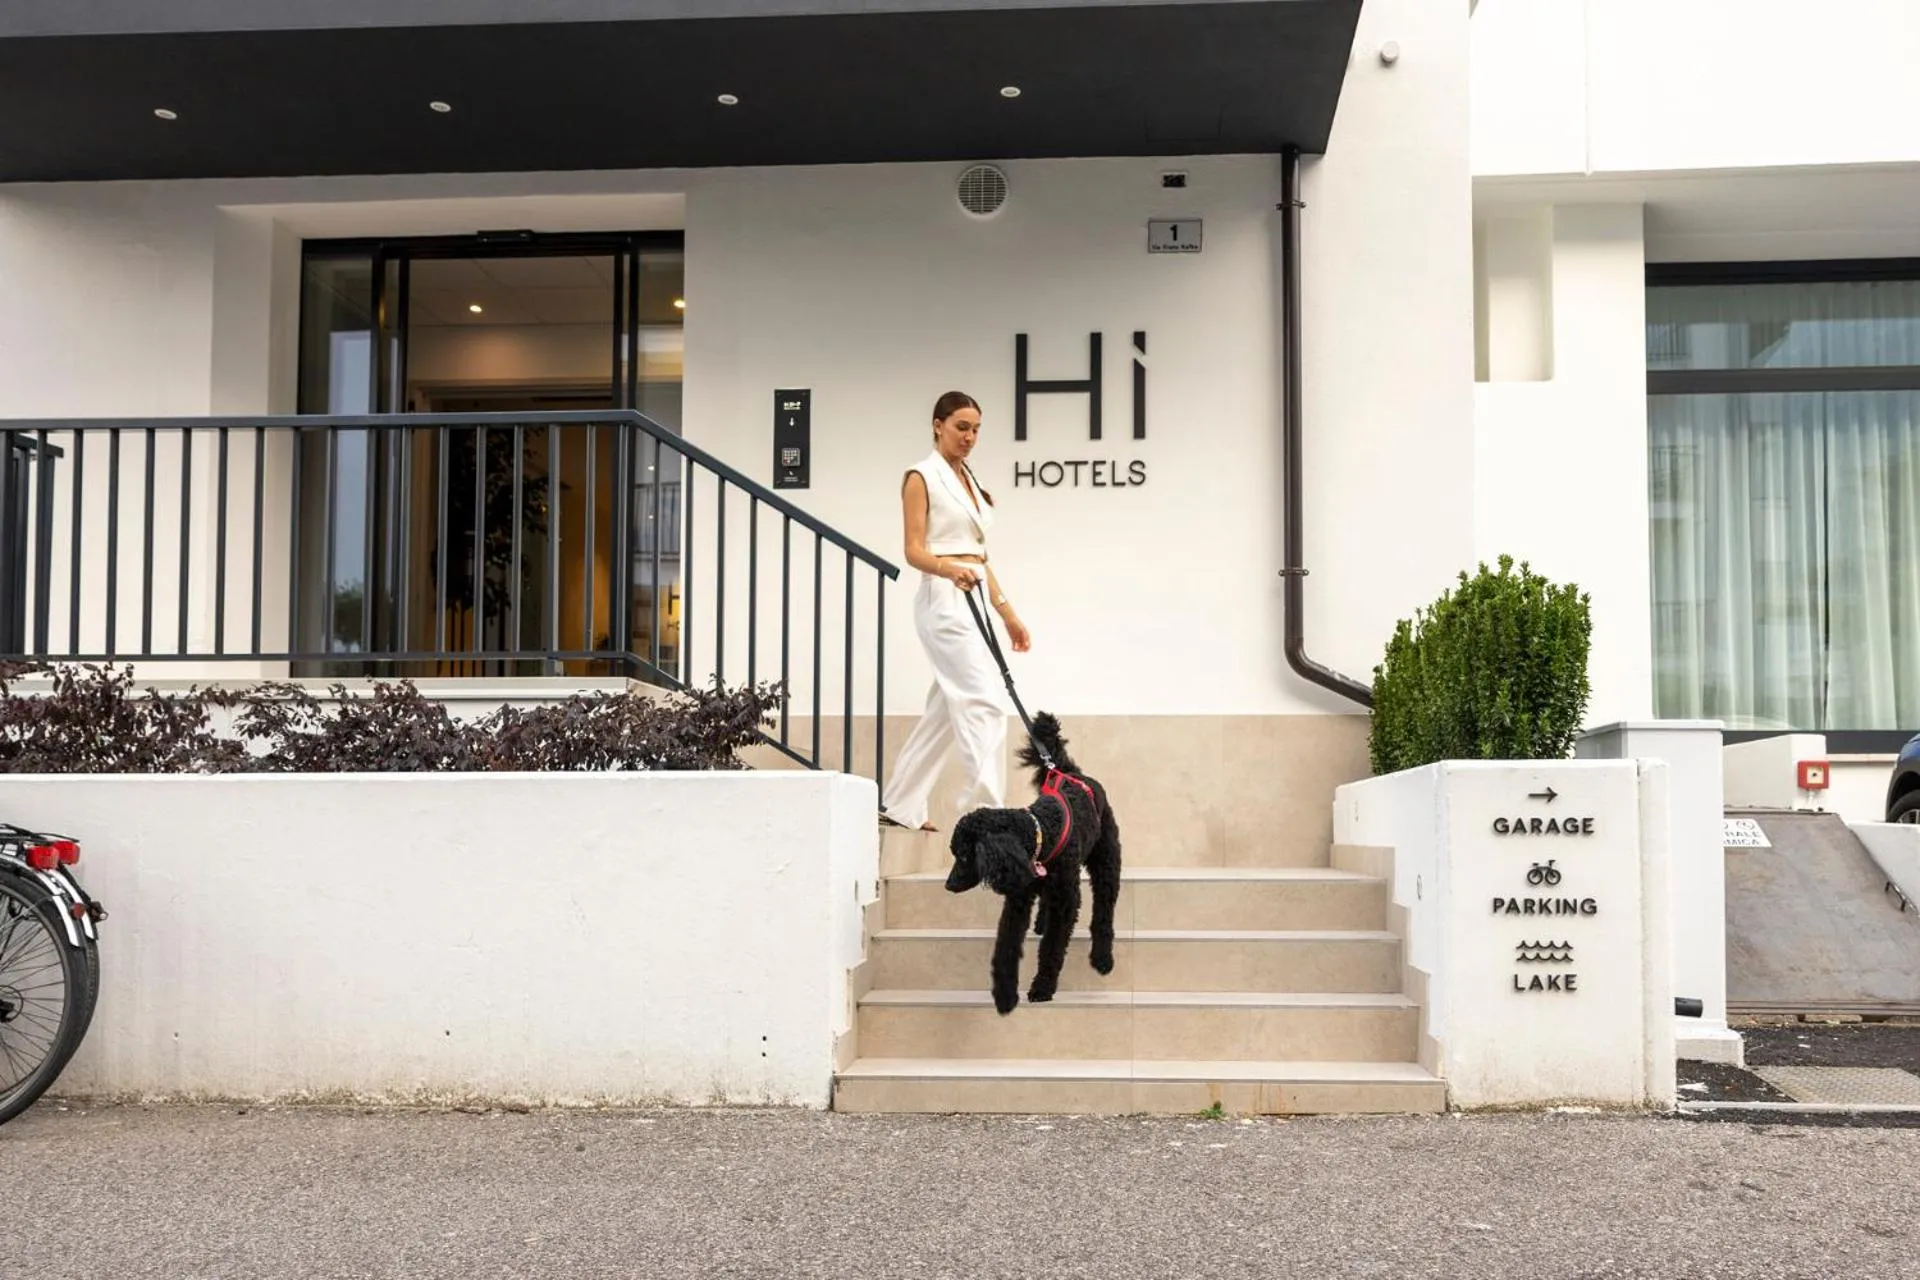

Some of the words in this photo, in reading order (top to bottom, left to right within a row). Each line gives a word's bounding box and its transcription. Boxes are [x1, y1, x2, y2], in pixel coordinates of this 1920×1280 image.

[1169, 224, 1178, 241] 1
[1014, 331, 1146, 441] Hi
[1014, 460, 1146, 488] HOTELS
[1492, 817, 1596, 835] GARAGE
[1492, 897, 1598, 916] PARKING
[1513, 973, 1579, 992] LAKE
